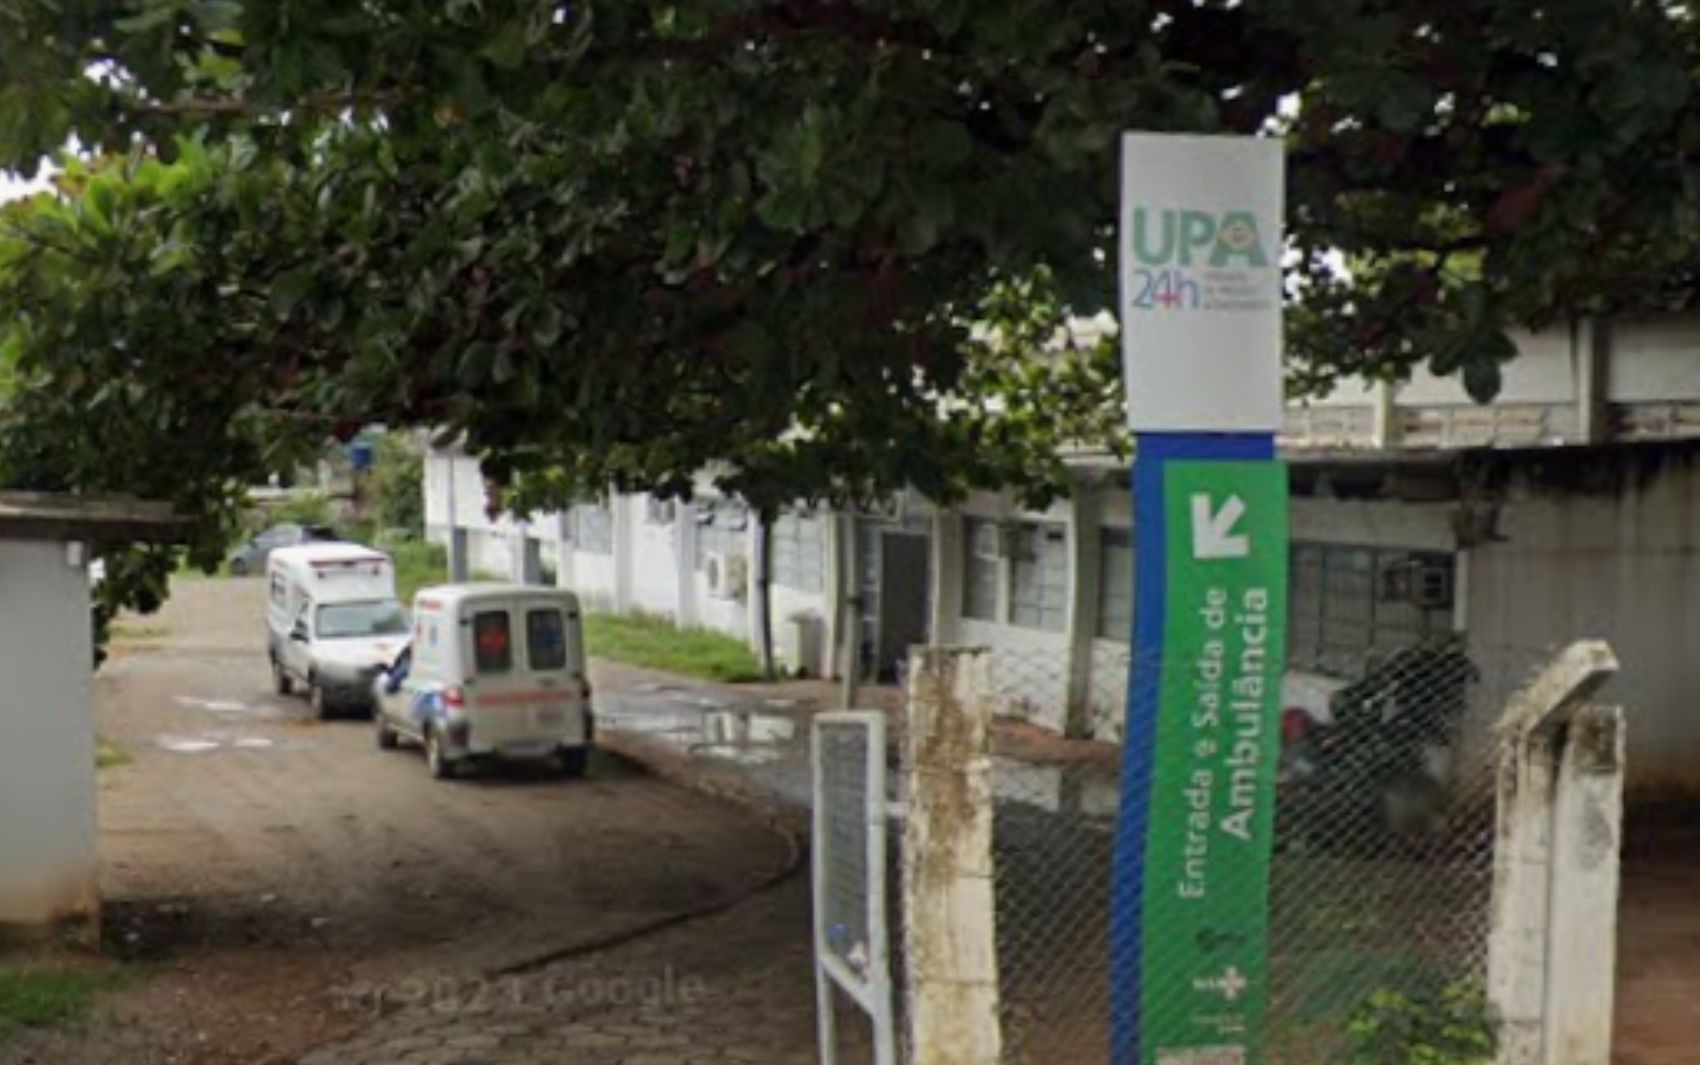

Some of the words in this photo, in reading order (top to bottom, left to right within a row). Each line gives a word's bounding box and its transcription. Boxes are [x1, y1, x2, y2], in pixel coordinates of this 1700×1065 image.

[1132, 207, 1268, 267] UPA
[1133, 268, 1199, 309] 24h
[1197, 585, 1228, 631] de
[1190, 639, 1224, 728] Saída
[1219, 586, 1269, 841] Ambulância
[1193, 738, 1217, 757] e
[1177, 768, 1215, 899] Entrada
